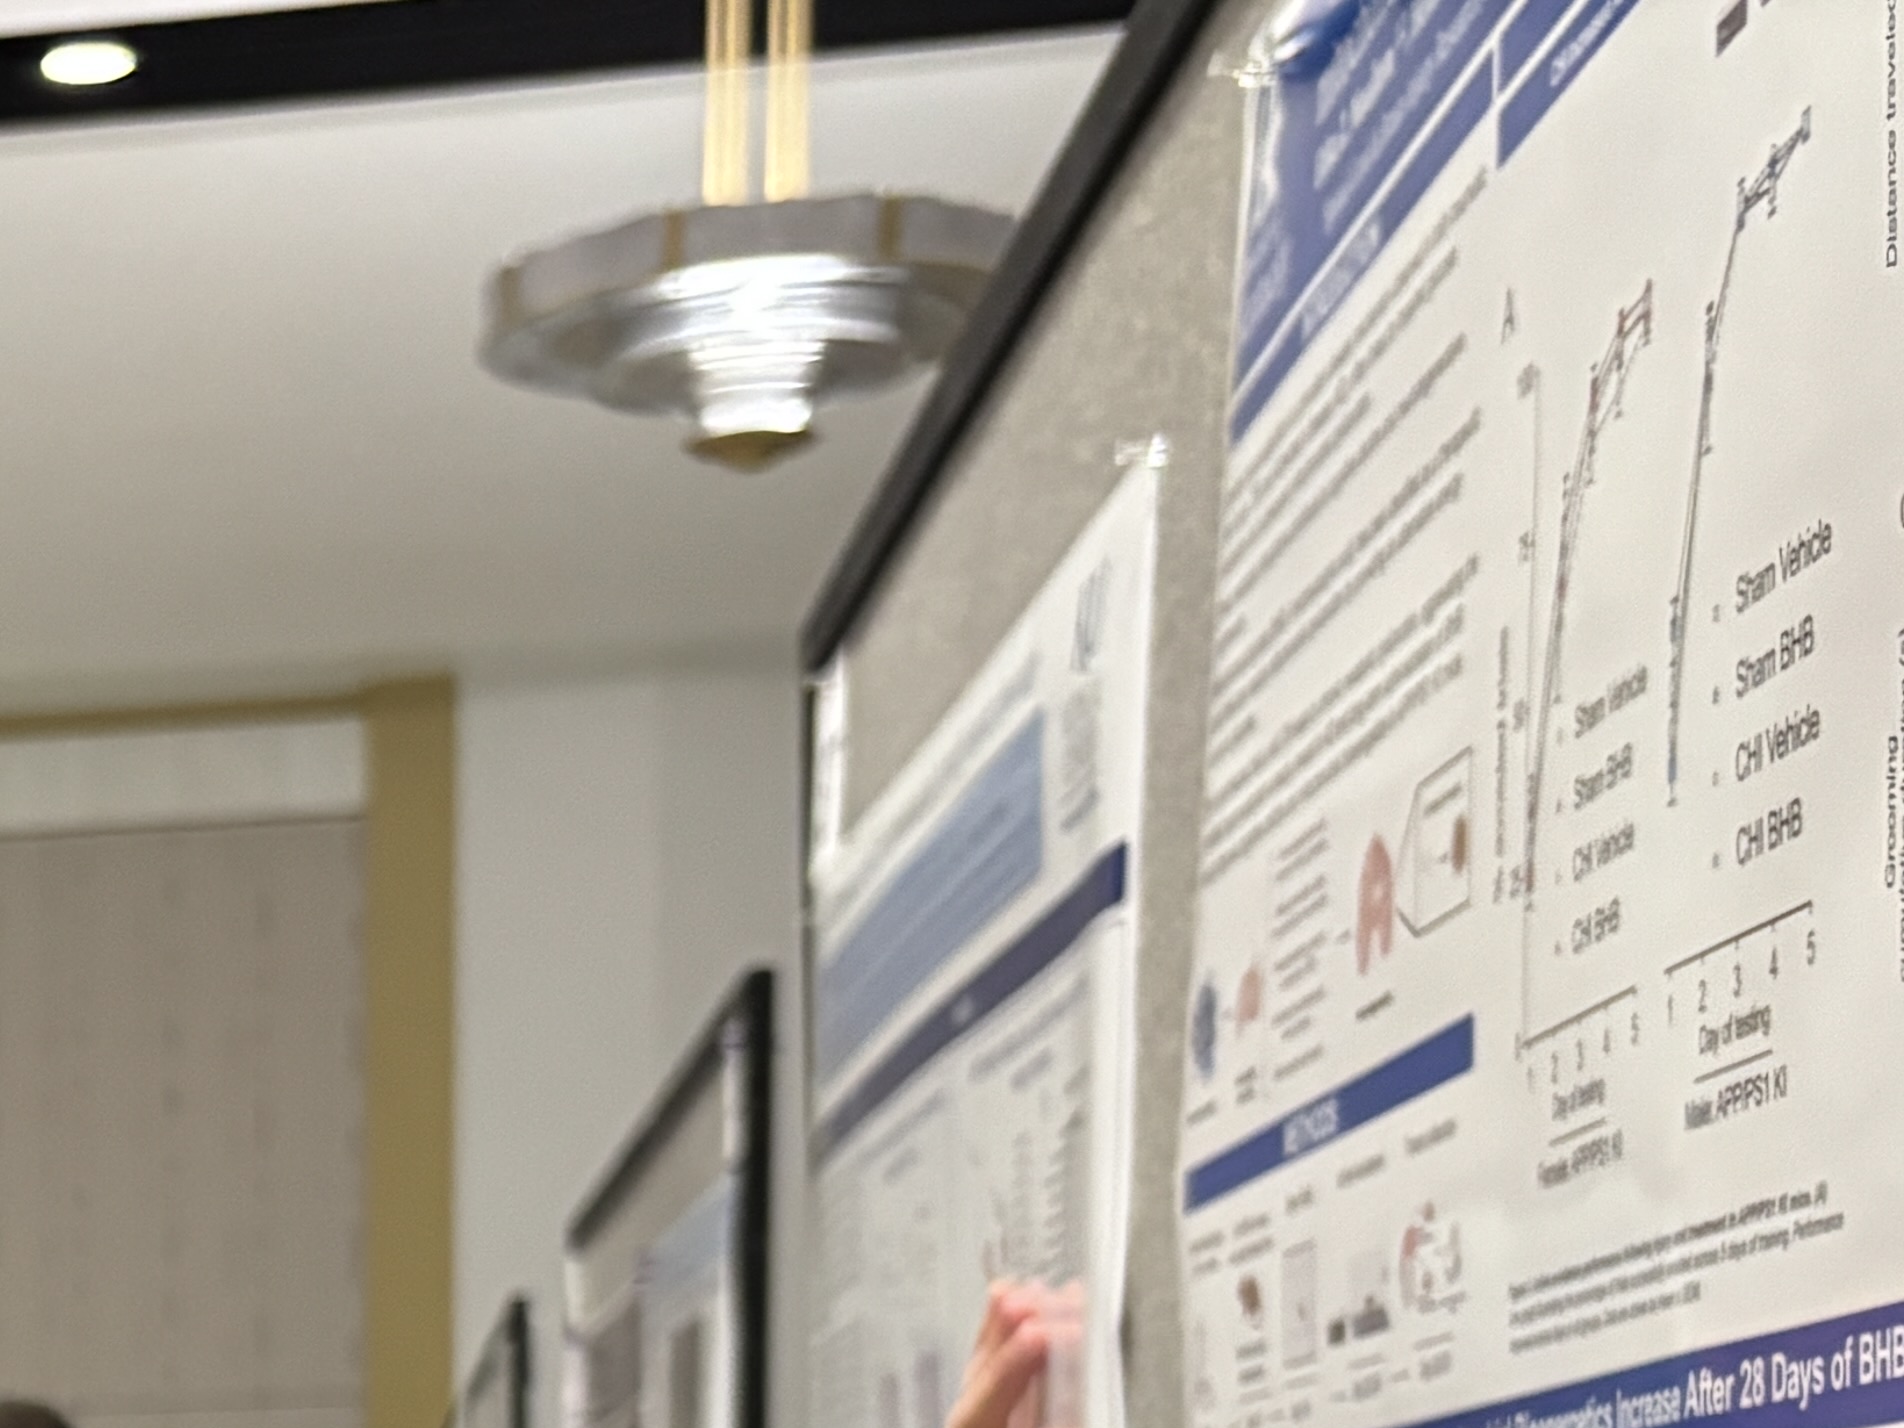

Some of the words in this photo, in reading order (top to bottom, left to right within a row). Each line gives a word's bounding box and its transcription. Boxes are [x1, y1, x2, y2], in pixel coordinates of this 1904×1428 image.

[1886, 129, 1898, 268] Distance
[1778, 518, 1832, 584] Vehicle
[1780, 613, 1815, 673] BHB
[1765, 703, 1821, 764] Vehicle
[1767, 796, 1803, 852] BHB
[1884, 735, 1899, 889] Grooming
[1698, 978, 1707, 1014] 2
[1807, 929, 1816, 966] 5
[1683, 1367, 1735, 1420] After
[1739, 1357, 1764, 1410] 28
[1771, 1348, 1825, 1411] Days
[1830, 1333, 1855, 1390] of
[1859, 1321, 1904, 1383] BHB
